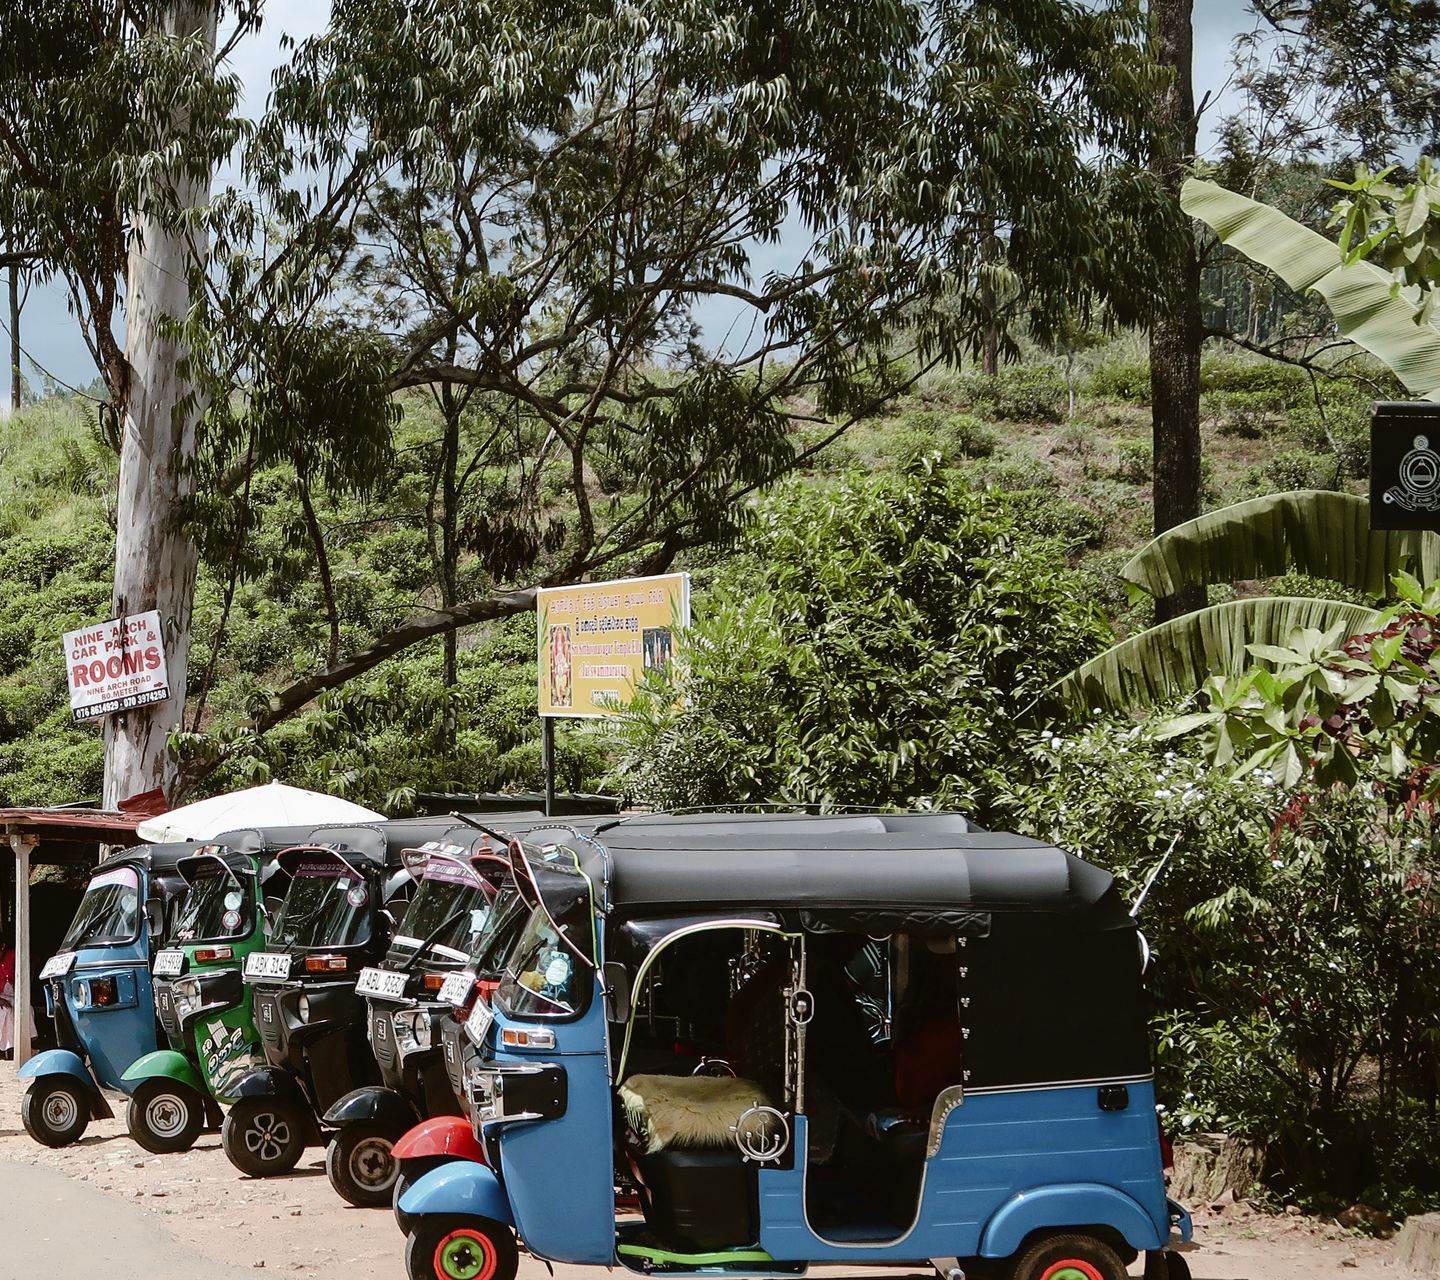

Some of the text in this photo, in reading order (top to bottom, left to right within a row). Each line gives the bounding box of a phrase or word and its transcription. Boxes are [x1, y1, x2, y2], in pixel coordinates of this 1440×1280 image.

[74, 620, 147, 647] NINE ARCH
[72, 631, 157, 660] CAR PARK &
[72, 646, 161, 688] ROOMS
[87, 675, 151, 696] NINE ARCH ROAD
[76, 708, 90, 719] 076
[123, 697, 137, 708] 070
[254, 957, 270, 973] ABK
[270, 957, 289, 974] 3142
[366, 972, 381, 990] ABL
